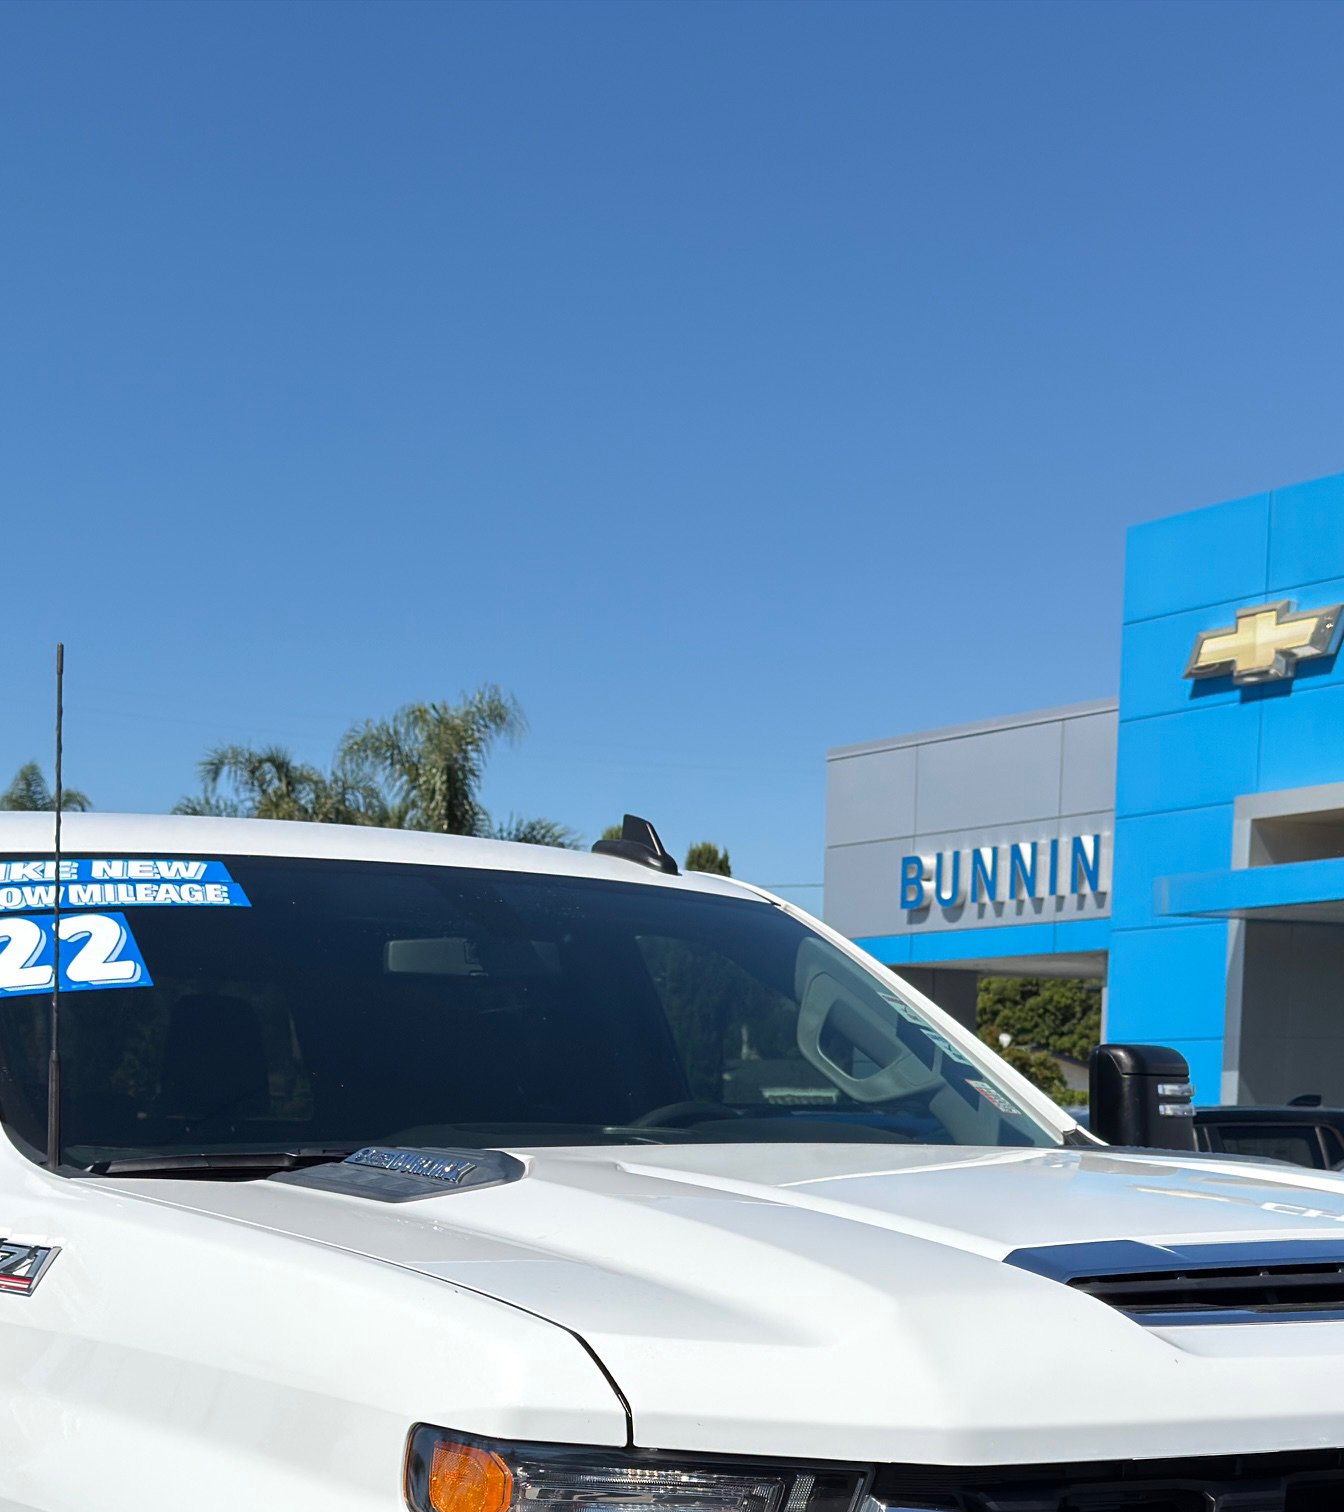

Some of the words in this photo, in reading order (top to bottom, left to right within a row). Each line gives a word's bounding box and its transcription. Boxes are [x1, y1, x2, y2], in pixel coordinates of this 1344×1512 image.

[91, 860, 208, 880] NEW
[900, 834, 1102, 911] BUNNIN
[68, 883, 231, 906] MILEAGE
